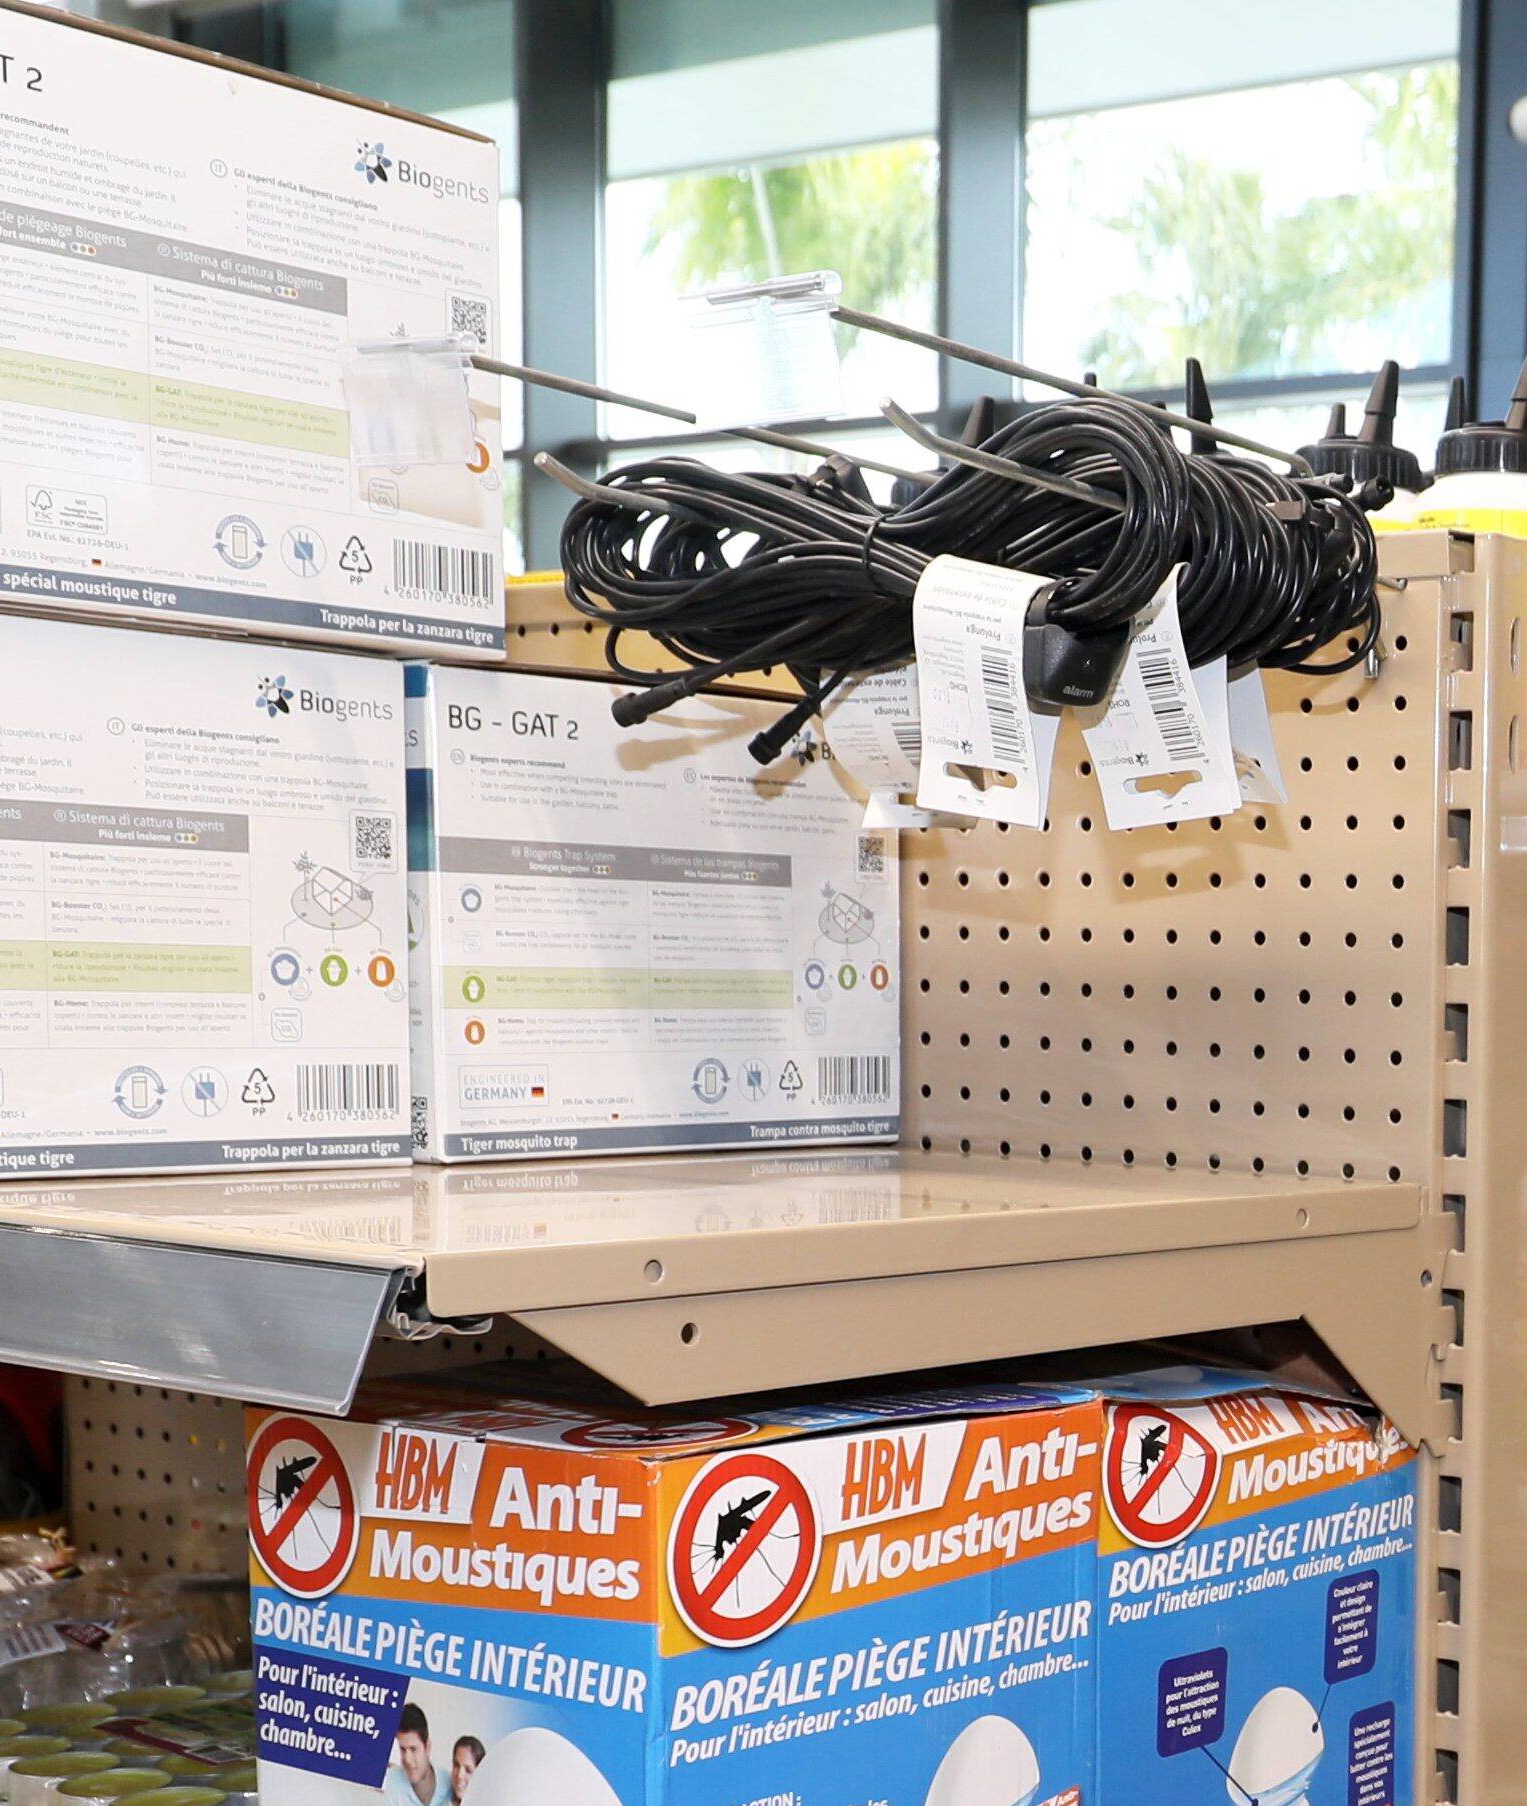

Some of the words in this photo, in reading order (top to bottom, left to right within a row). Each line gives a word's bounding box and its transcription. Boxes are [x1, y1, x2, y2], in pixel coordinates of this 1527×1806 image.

[27, 65, 45, 92] 2
[398, 159, 490, 206] Biogents
[4, 568, 57, 593] spécial
[61, 576, 137, 603] moustique
[141, 584, 177, 607] tigre
[299, 689, 393, 721] Biogents
[1061, 682, 1096, 700] alarm
[69, 810, 116, 825] Sistema
[119, 813, 131, 828] di
[134, 815, 174, 831] cattura
[177, 818, 225, 836] Biogents
[522, 846, 562, 864] Biogents
[565, 847, 583, 865] Trap
[585, 849, 617, 867] System
[461, 1137, 490, 1155] Tiger
[493, 1135, 548, 1154] mosquito
[550, 1135, 578, 1152] trap
[750, 1125, 787, 1142] Trampa
[789, 1125, 820, 1139] contra
[822, 1121, 866, 1140] mosquito
[868, 1120, 891, 1137] tigre
[375, 1431, 459, 1514] HBM
[491, 1467, 643, 1535] Anti-
[842, 1432, 928, 1520] HBM
[968, 1426, 1098, 1500] Anti-
[831, 1491, 1093, 1594] Moustiques
[371, 1529, 640, 1607] Moustiques
[255, 1596, 373, 1660] BORÉALE
[377, 1618, 463, 1677] PIÈGE
[472, 1639, 646, 1712] INTÉRIEUR
[671, 1657, 826, 1732] BORÉALE
[829, 1637, 930, 1697] PIÈGE
[935, 1602, 1091, 1674] INTÉRIEUR
[258, 1656, 299, 1688] Pour
[301, 1667, 390, 1706] l'intérieur
[258, 1688, 311, 1721] salon,
[314, 1703, 381, 1739] cuisine,
[260, 1721, 352, 1761] chambre...
